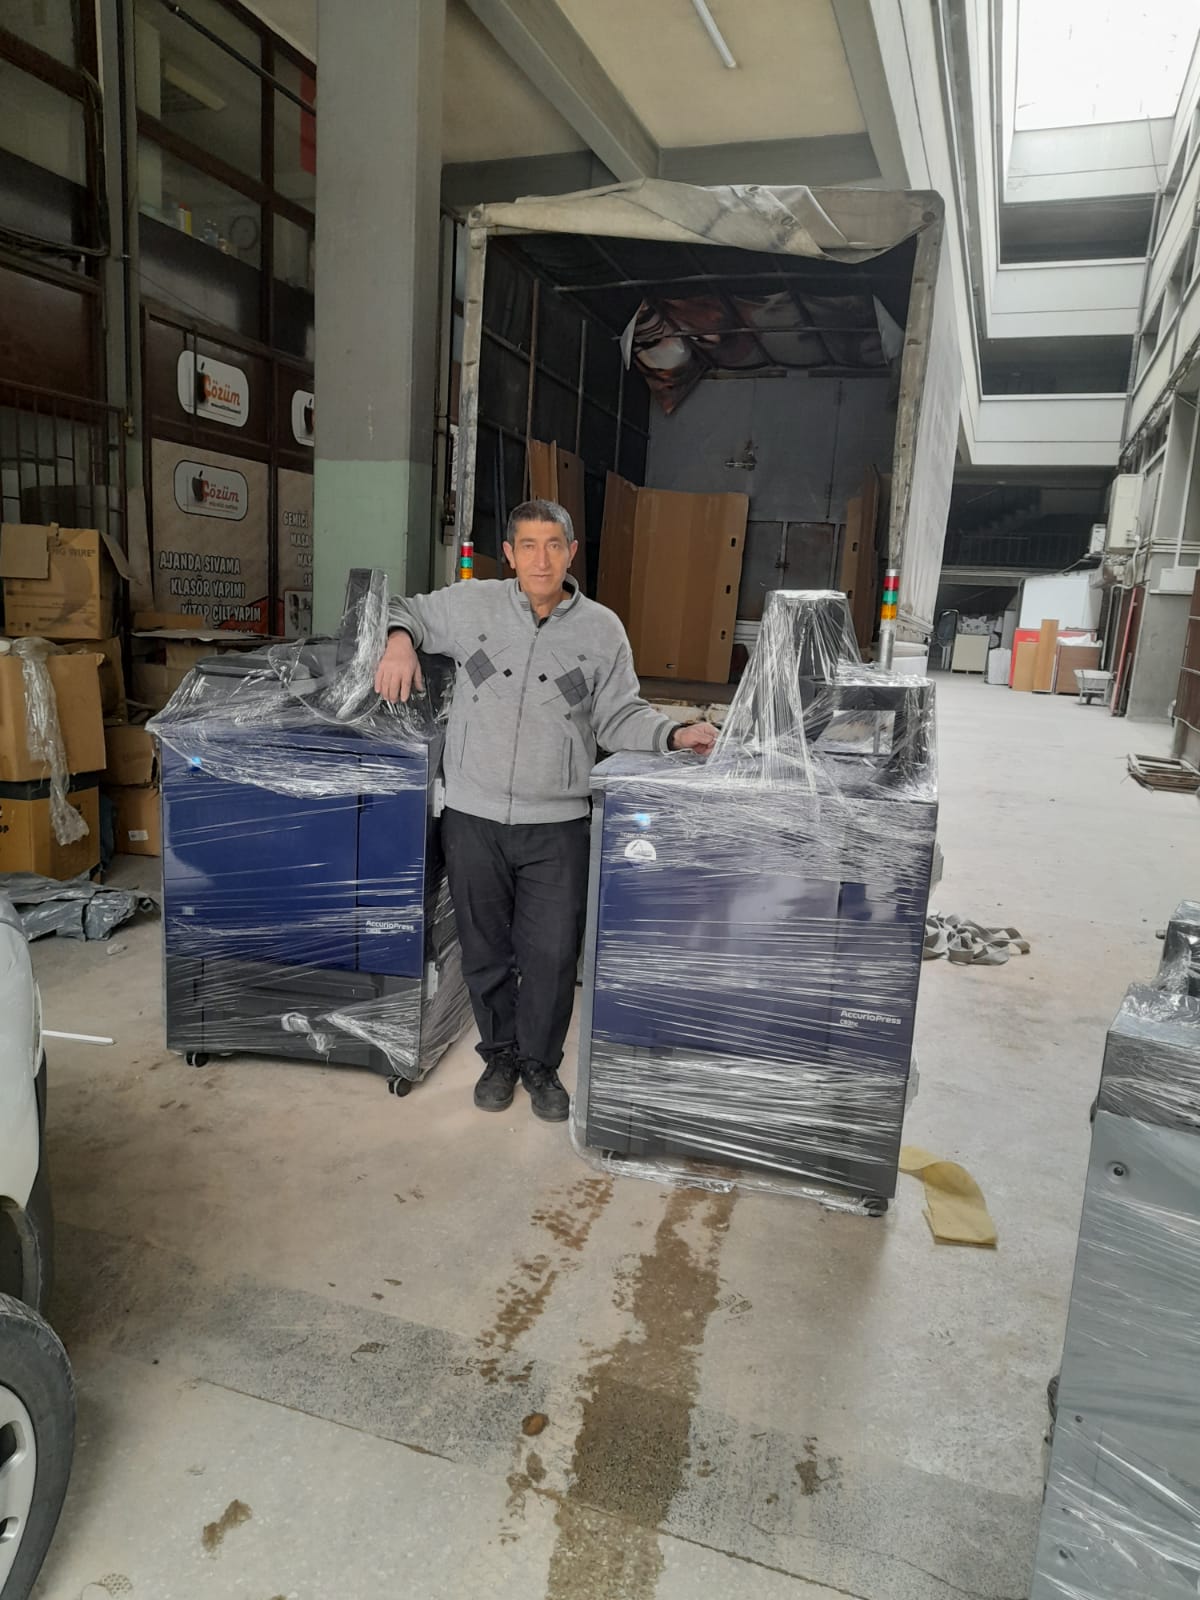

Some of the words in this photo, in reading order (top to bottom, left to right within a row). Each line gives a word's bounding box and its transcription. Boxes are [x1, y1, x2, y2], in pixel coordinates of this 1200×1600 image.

[159, 551, 202, 571] AJANDA
[204, 555, 241, 575] SIVAMA
[170, 575, 210, 597] KLASÖR
[212, 581, 246, 598] YAPIMI
[840, 1010, 902, 1025] AccurioPress
